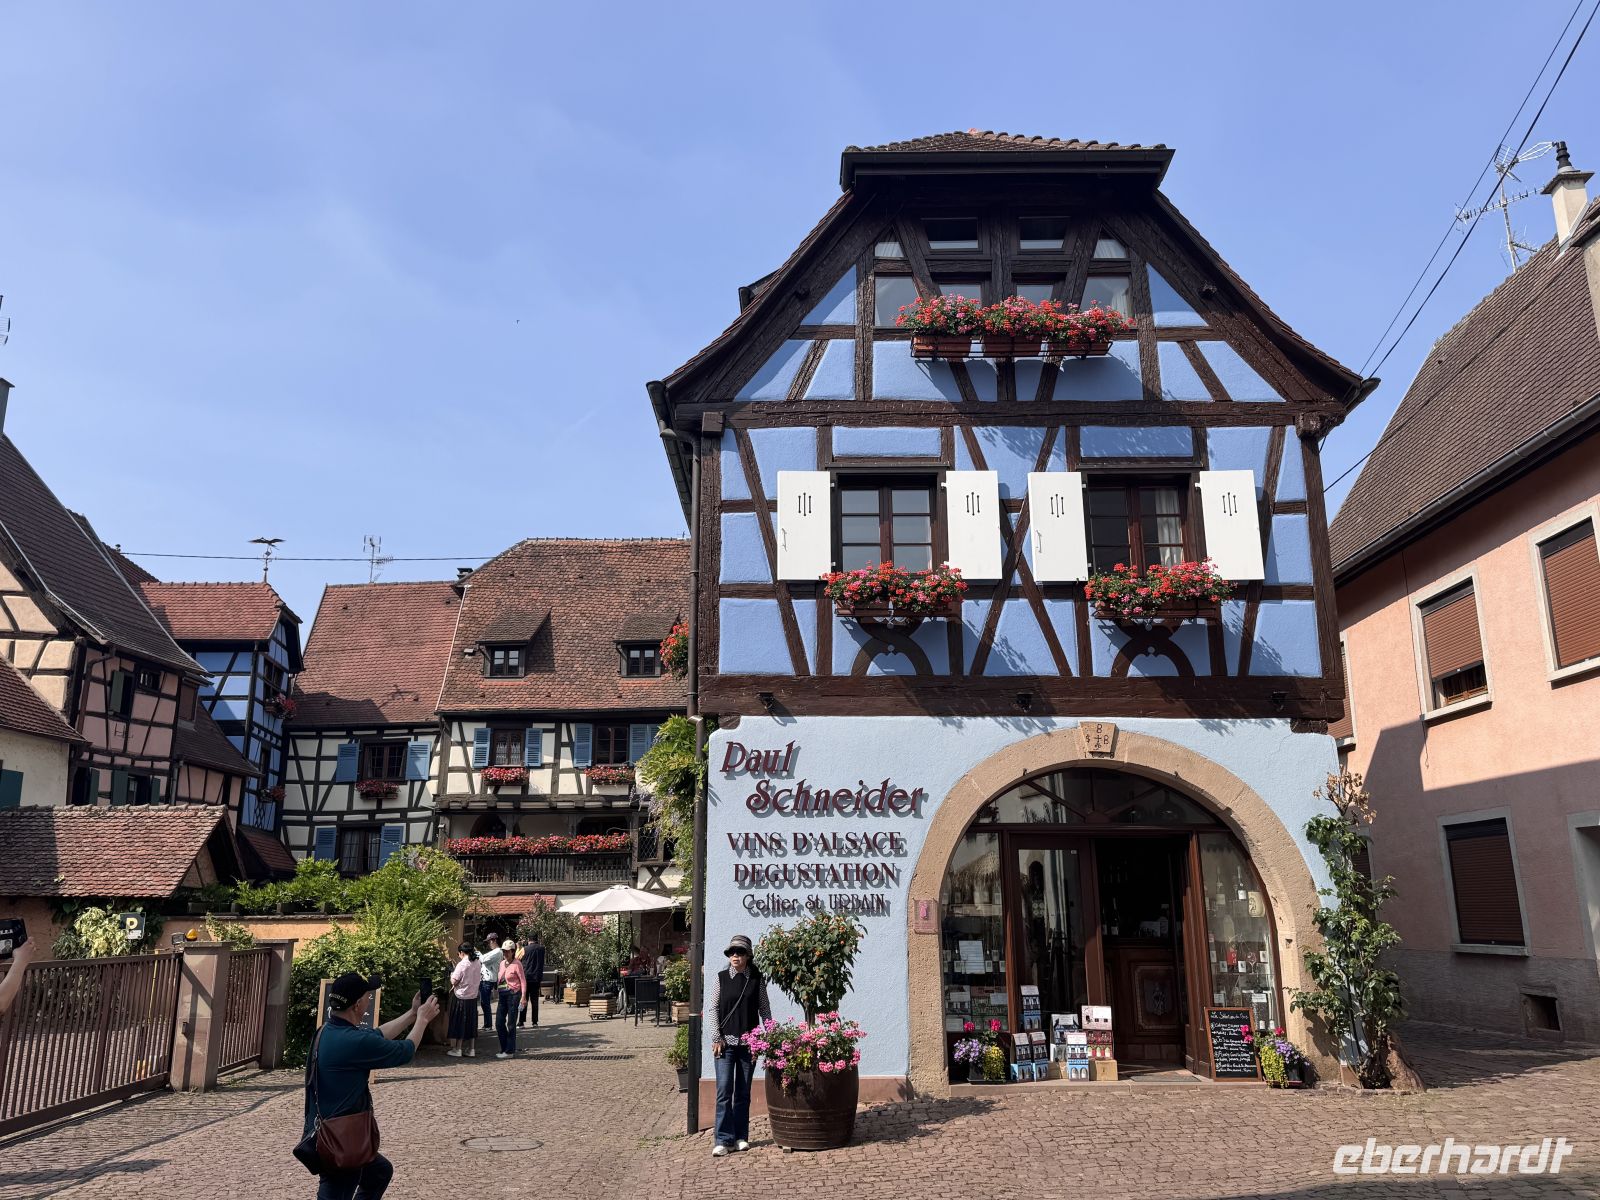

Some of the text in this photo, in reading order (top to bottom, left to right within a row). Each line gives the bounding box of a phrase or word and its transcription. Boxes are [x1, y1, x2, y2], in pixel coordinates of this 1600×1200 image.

[720, 740, 796, 772] Paul
[746, 777, 924, 812] Schneider
[727, 831, 902, 851] VINS D'ALSACE
[733, 862, 897, 883] DEGUSTATION
[742, 893, 886, 911] Cellier St URBAIN
